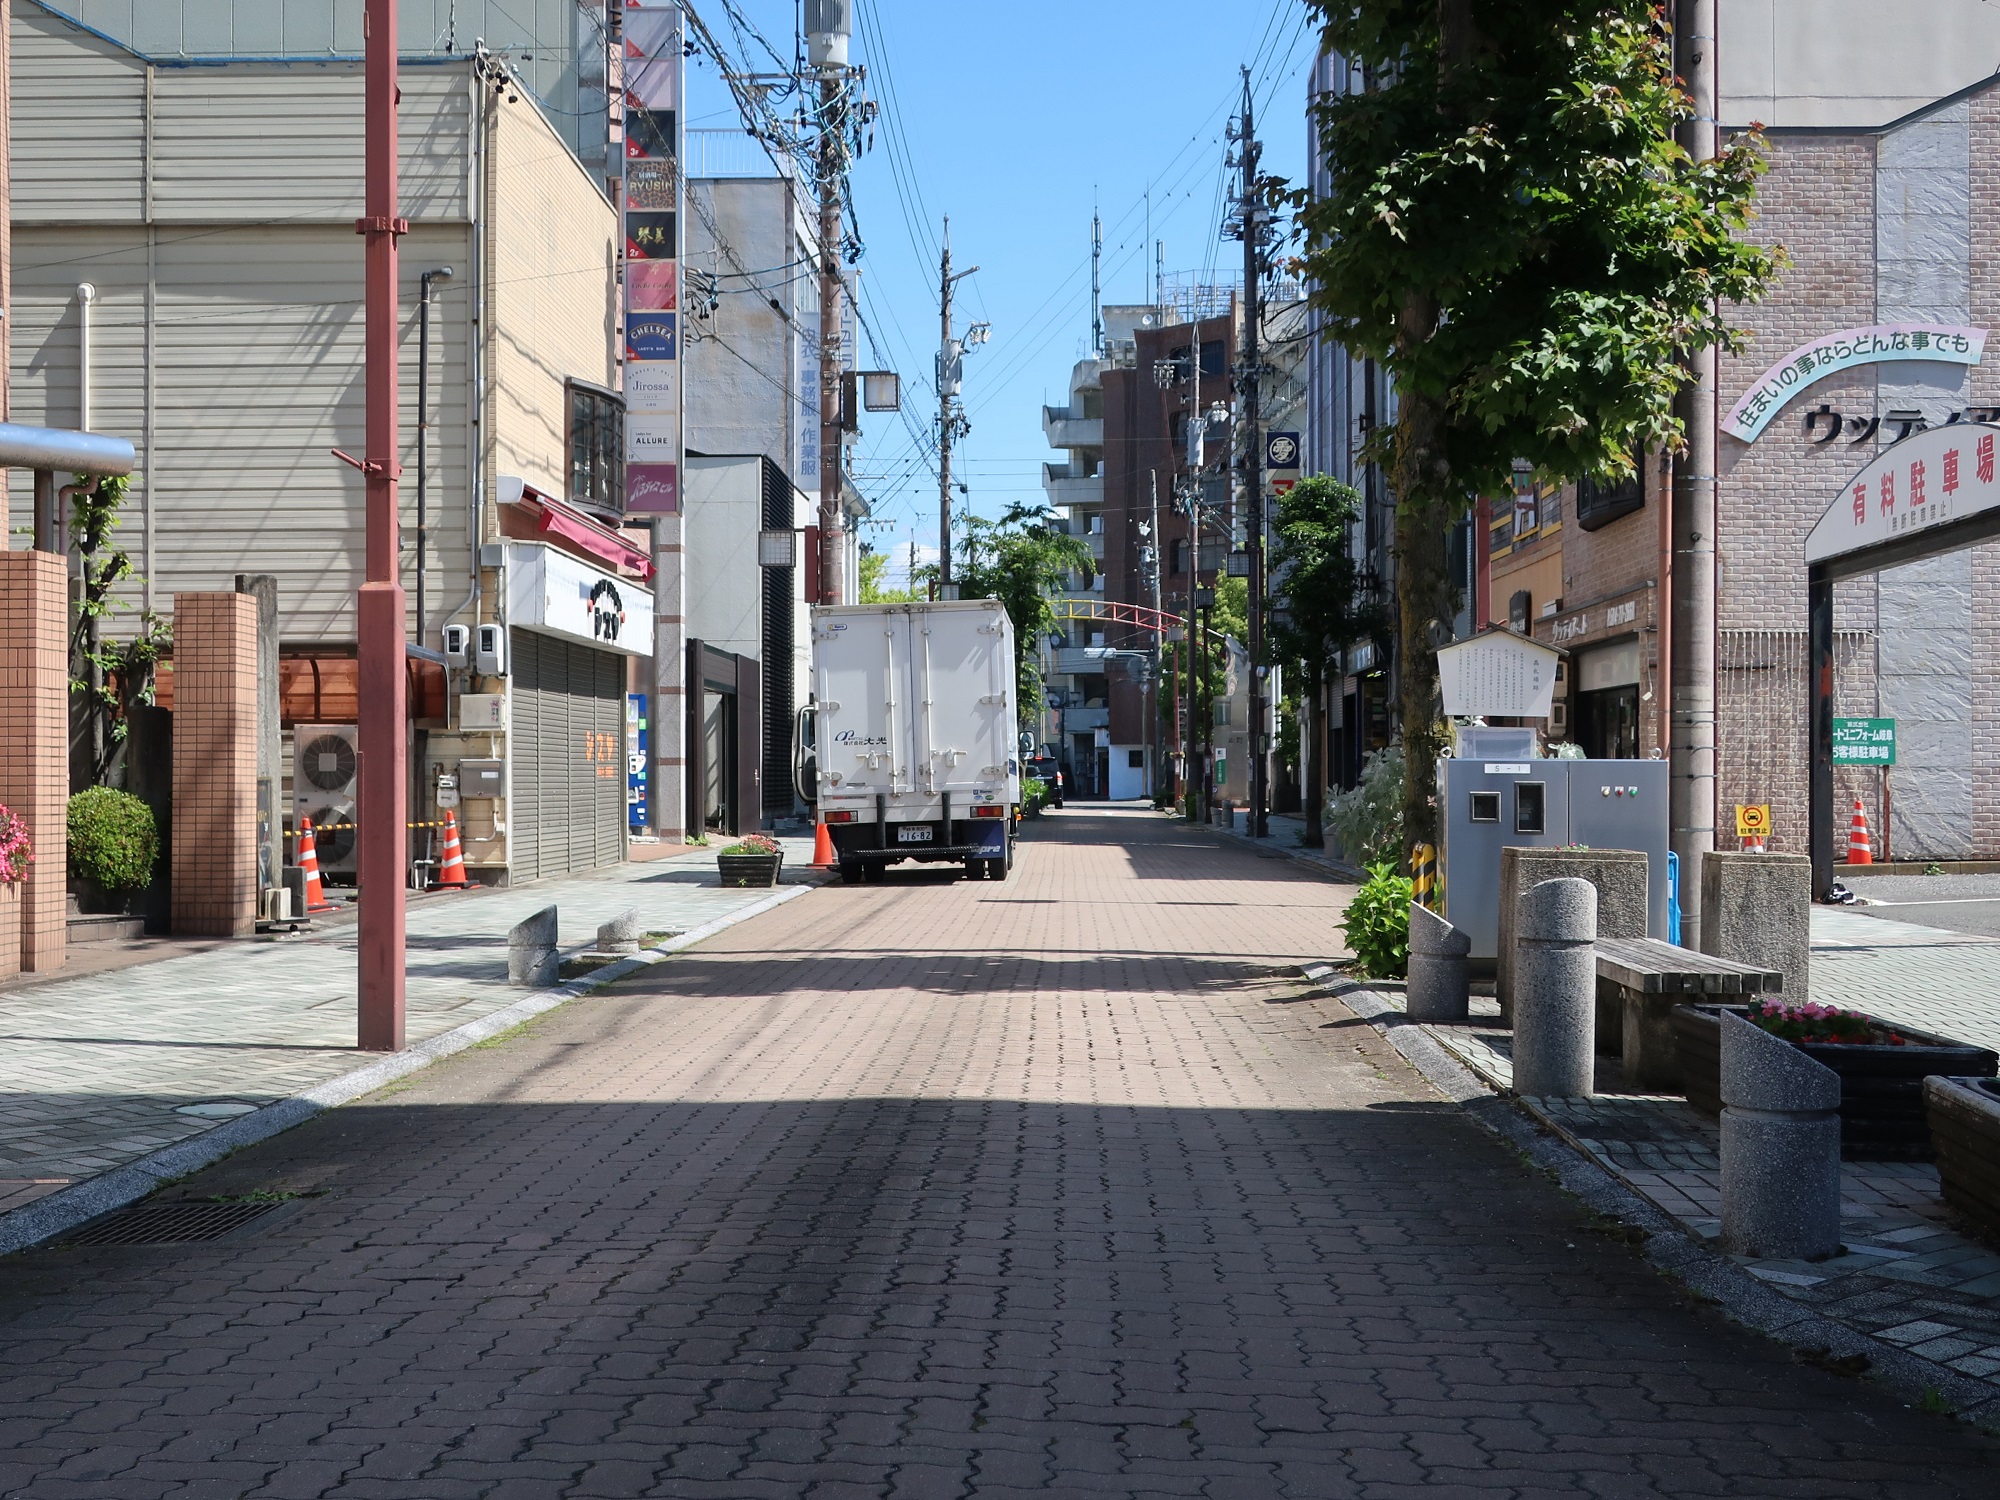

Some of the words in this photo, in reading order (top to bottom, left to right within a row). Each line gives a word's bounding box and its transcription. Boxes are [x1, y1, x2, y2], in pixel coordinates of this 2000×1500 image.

[629, 147, 639, 156] 3F
[629, 249, 639, 257] 2F
[630, 325, 672, 340] CHELSEA
[1736, 330, 1969, 429] 住まいの事ならどんな事でも
[632, 381, 669, 391] Jirossa
[1852, 433, 1995, 526] 有料駐車場
[1833, 746, 1889, 759] お客様駐車場
[906, 831, 931, 840] 16-82
